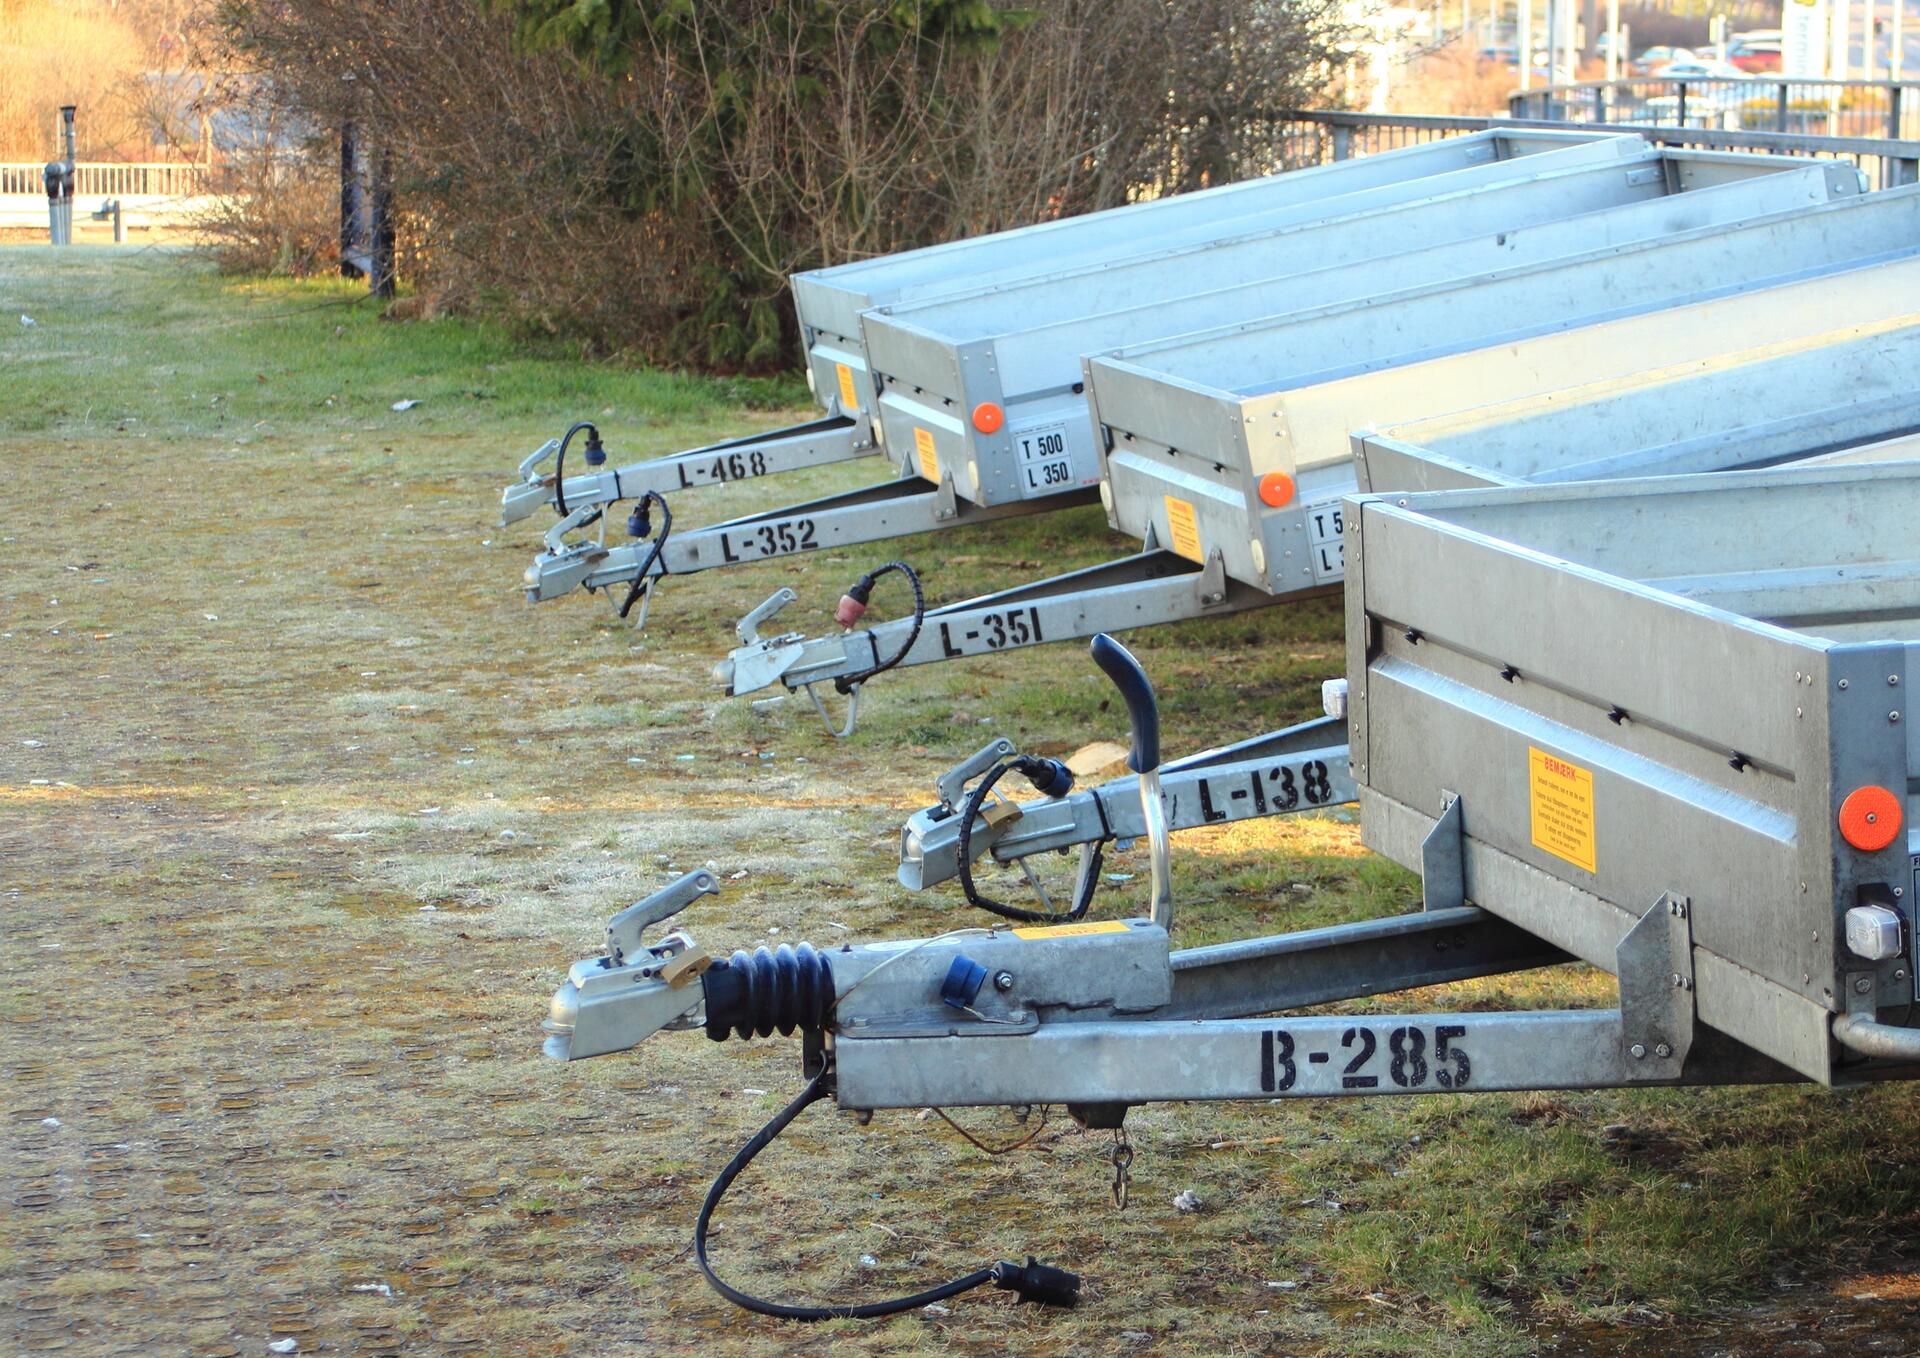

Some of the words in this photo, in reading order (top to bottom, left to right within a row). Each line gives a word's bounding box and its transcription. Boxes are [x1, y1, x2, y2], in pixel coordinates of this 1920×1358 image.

[1022, 440, 1031, 459] T
[1037, 433, 1063, 456] 500
[678, 451, 767, 488] L-468
[1028, 468, 1038, 487] L
[1043, 461, 1069, 484] 350
[720, 519, 818, 562] L-352
[1314, 514, 1325, 538] T
[1321, 548, 1332, 571] L
[940, 606, 1043, 657] L-351
[1198, 760, 1332, 823] L-138
[1261, 1025, 1471, 1092] B-285
